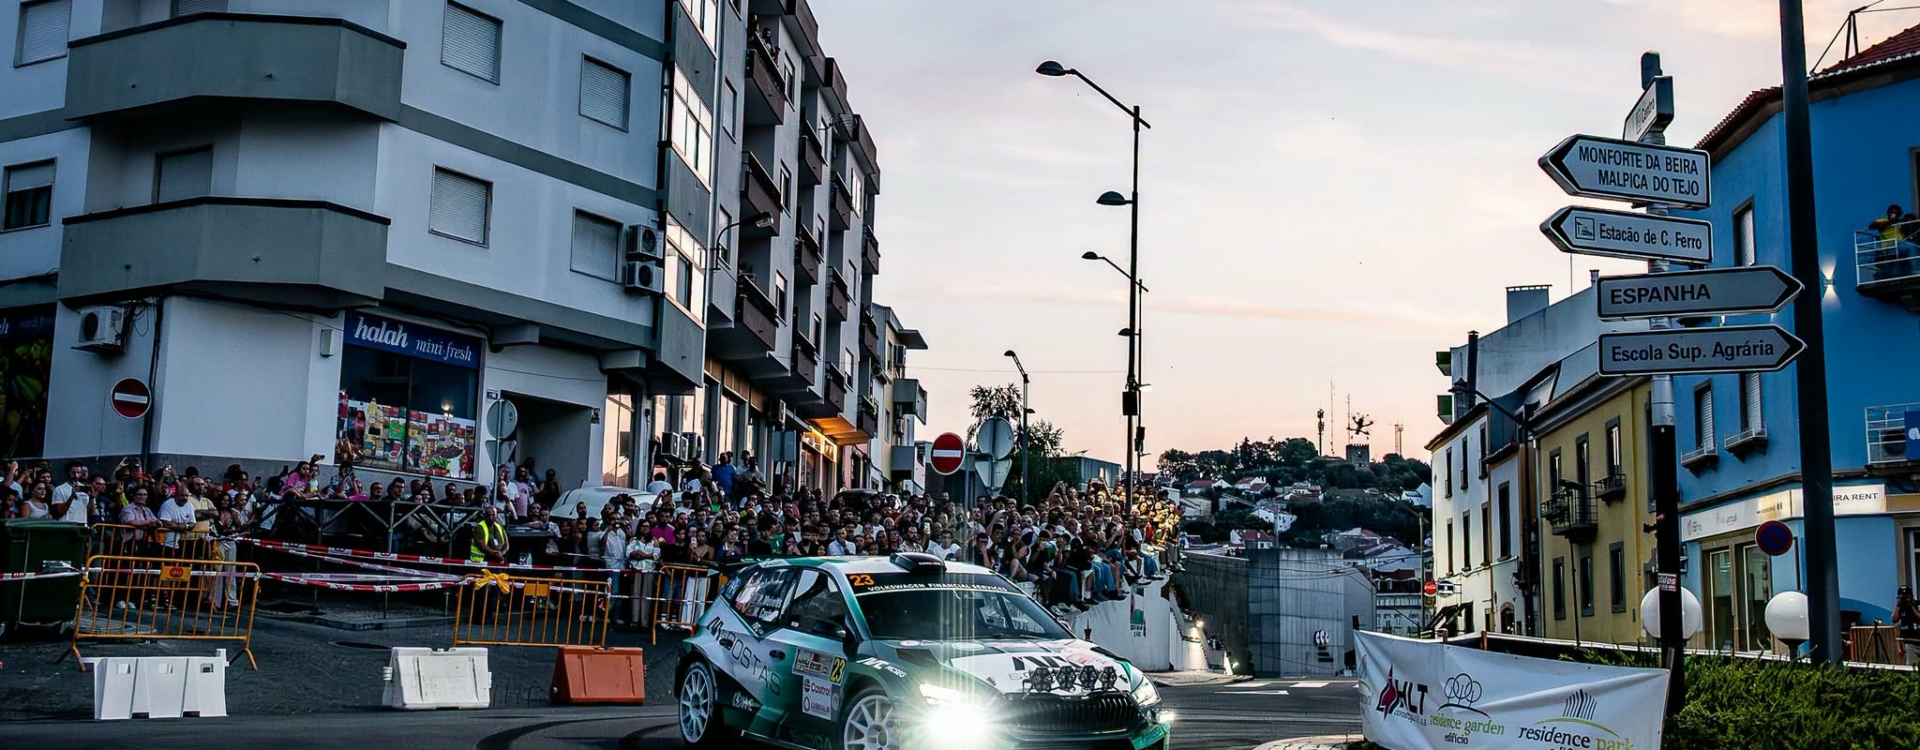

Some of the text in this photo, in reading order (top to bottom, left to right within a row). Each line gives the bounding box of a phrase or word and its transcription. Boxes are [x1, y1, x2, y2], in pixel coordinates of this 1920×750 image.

[1578, 146, 1699, 175] MONFORTE DA BEIRA
[1598, 169, 1699, 196] MALPICA DO TEJO
[1643, 230, 1656, 245] de
[1660, 230, 1672, 247] C.
[1675, 232, 1702, 249] Ferro
[1610, 283, 1711, 305] ESPANHA
[354, 316, 408, 348] halah
[1611, 340, 1774, 362] Escola Sup. Agrária
[1851, 492, 1878, 501] RENT
[849, 574, 875, 587] 23
[867, 583, 925, 592] VOLKSWAGEN
[971, 584, 1008, 593] SERVICES
[830, 657, 846, 682] 23
[1464, 718, 1505, 736] garden
[1518, 726, 1634, 750] residence park
